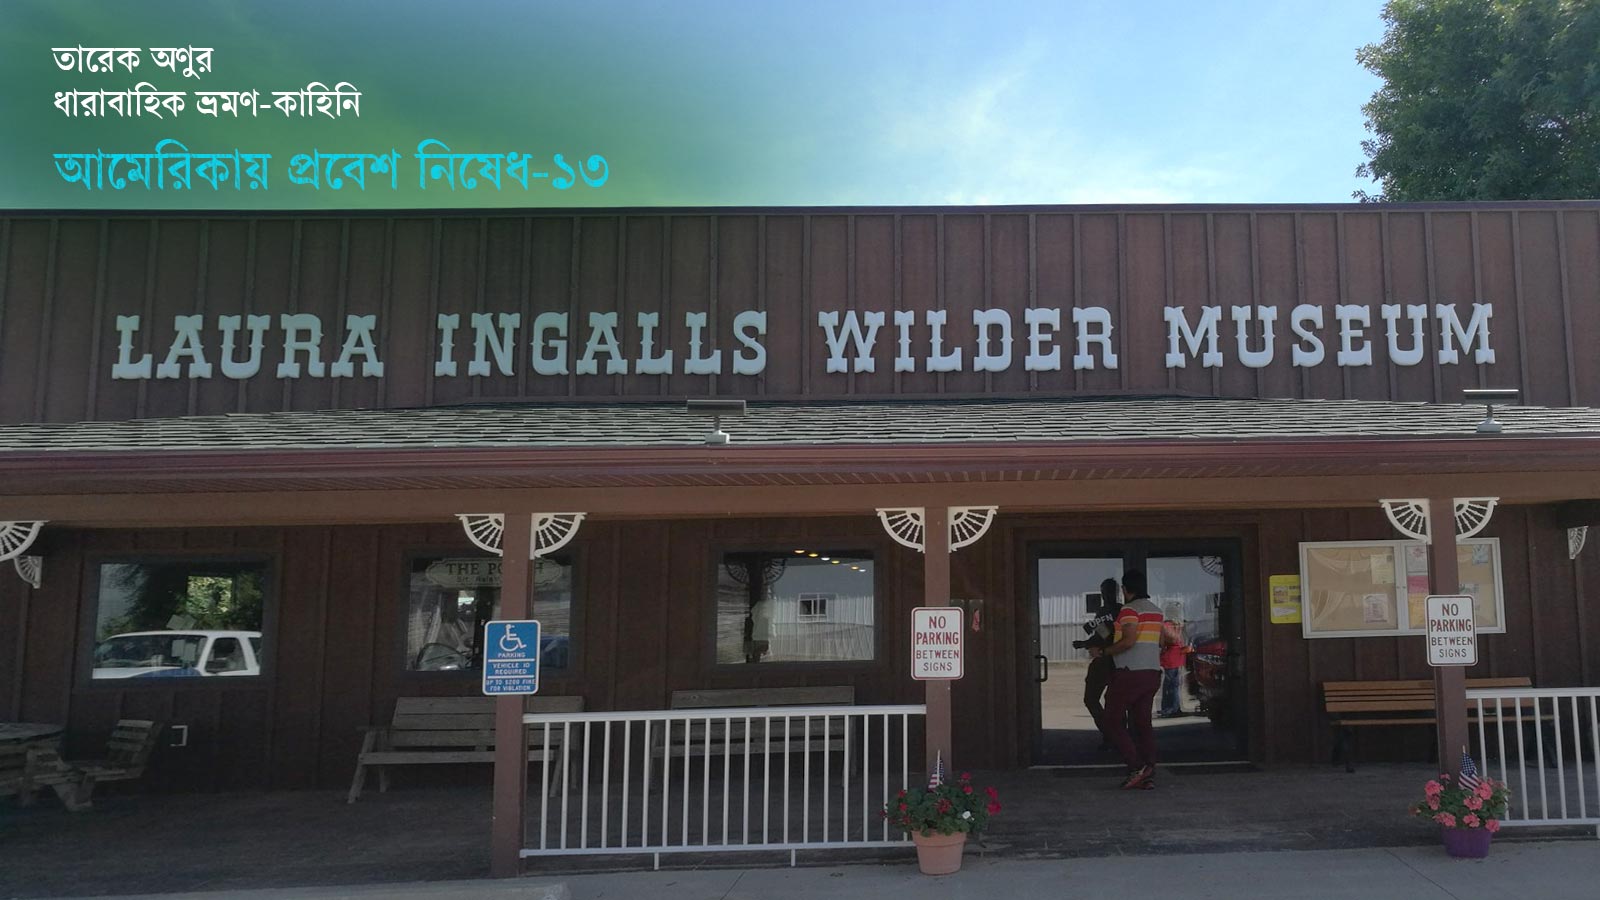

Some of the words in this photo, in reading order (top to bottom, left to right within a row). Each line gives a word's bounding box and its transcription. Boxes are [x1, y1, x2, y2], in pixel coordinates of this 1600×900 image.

[111, 313, 385, 380] LAURA
[435, 310, 768, 377] INGALLS
[818, 306, 1118, 374] WILDER
[1164, 302, 1496, 369] MUSEUM
[447, 562, 479, 576] THE
[1441, 603, 1459, 616] NO
[928, 615, 947, 629] NO
[1430, 619, 1472, 632] PARKING
[916, 632, 959, 645] PARKING
[1431, 636, 1473, 646] BETWEEN
[916, 650, 960, 659] BETWEEN
[1439, 648, 1467, 658] SIGNS
[923, 662, 953, 672] SIGNS
